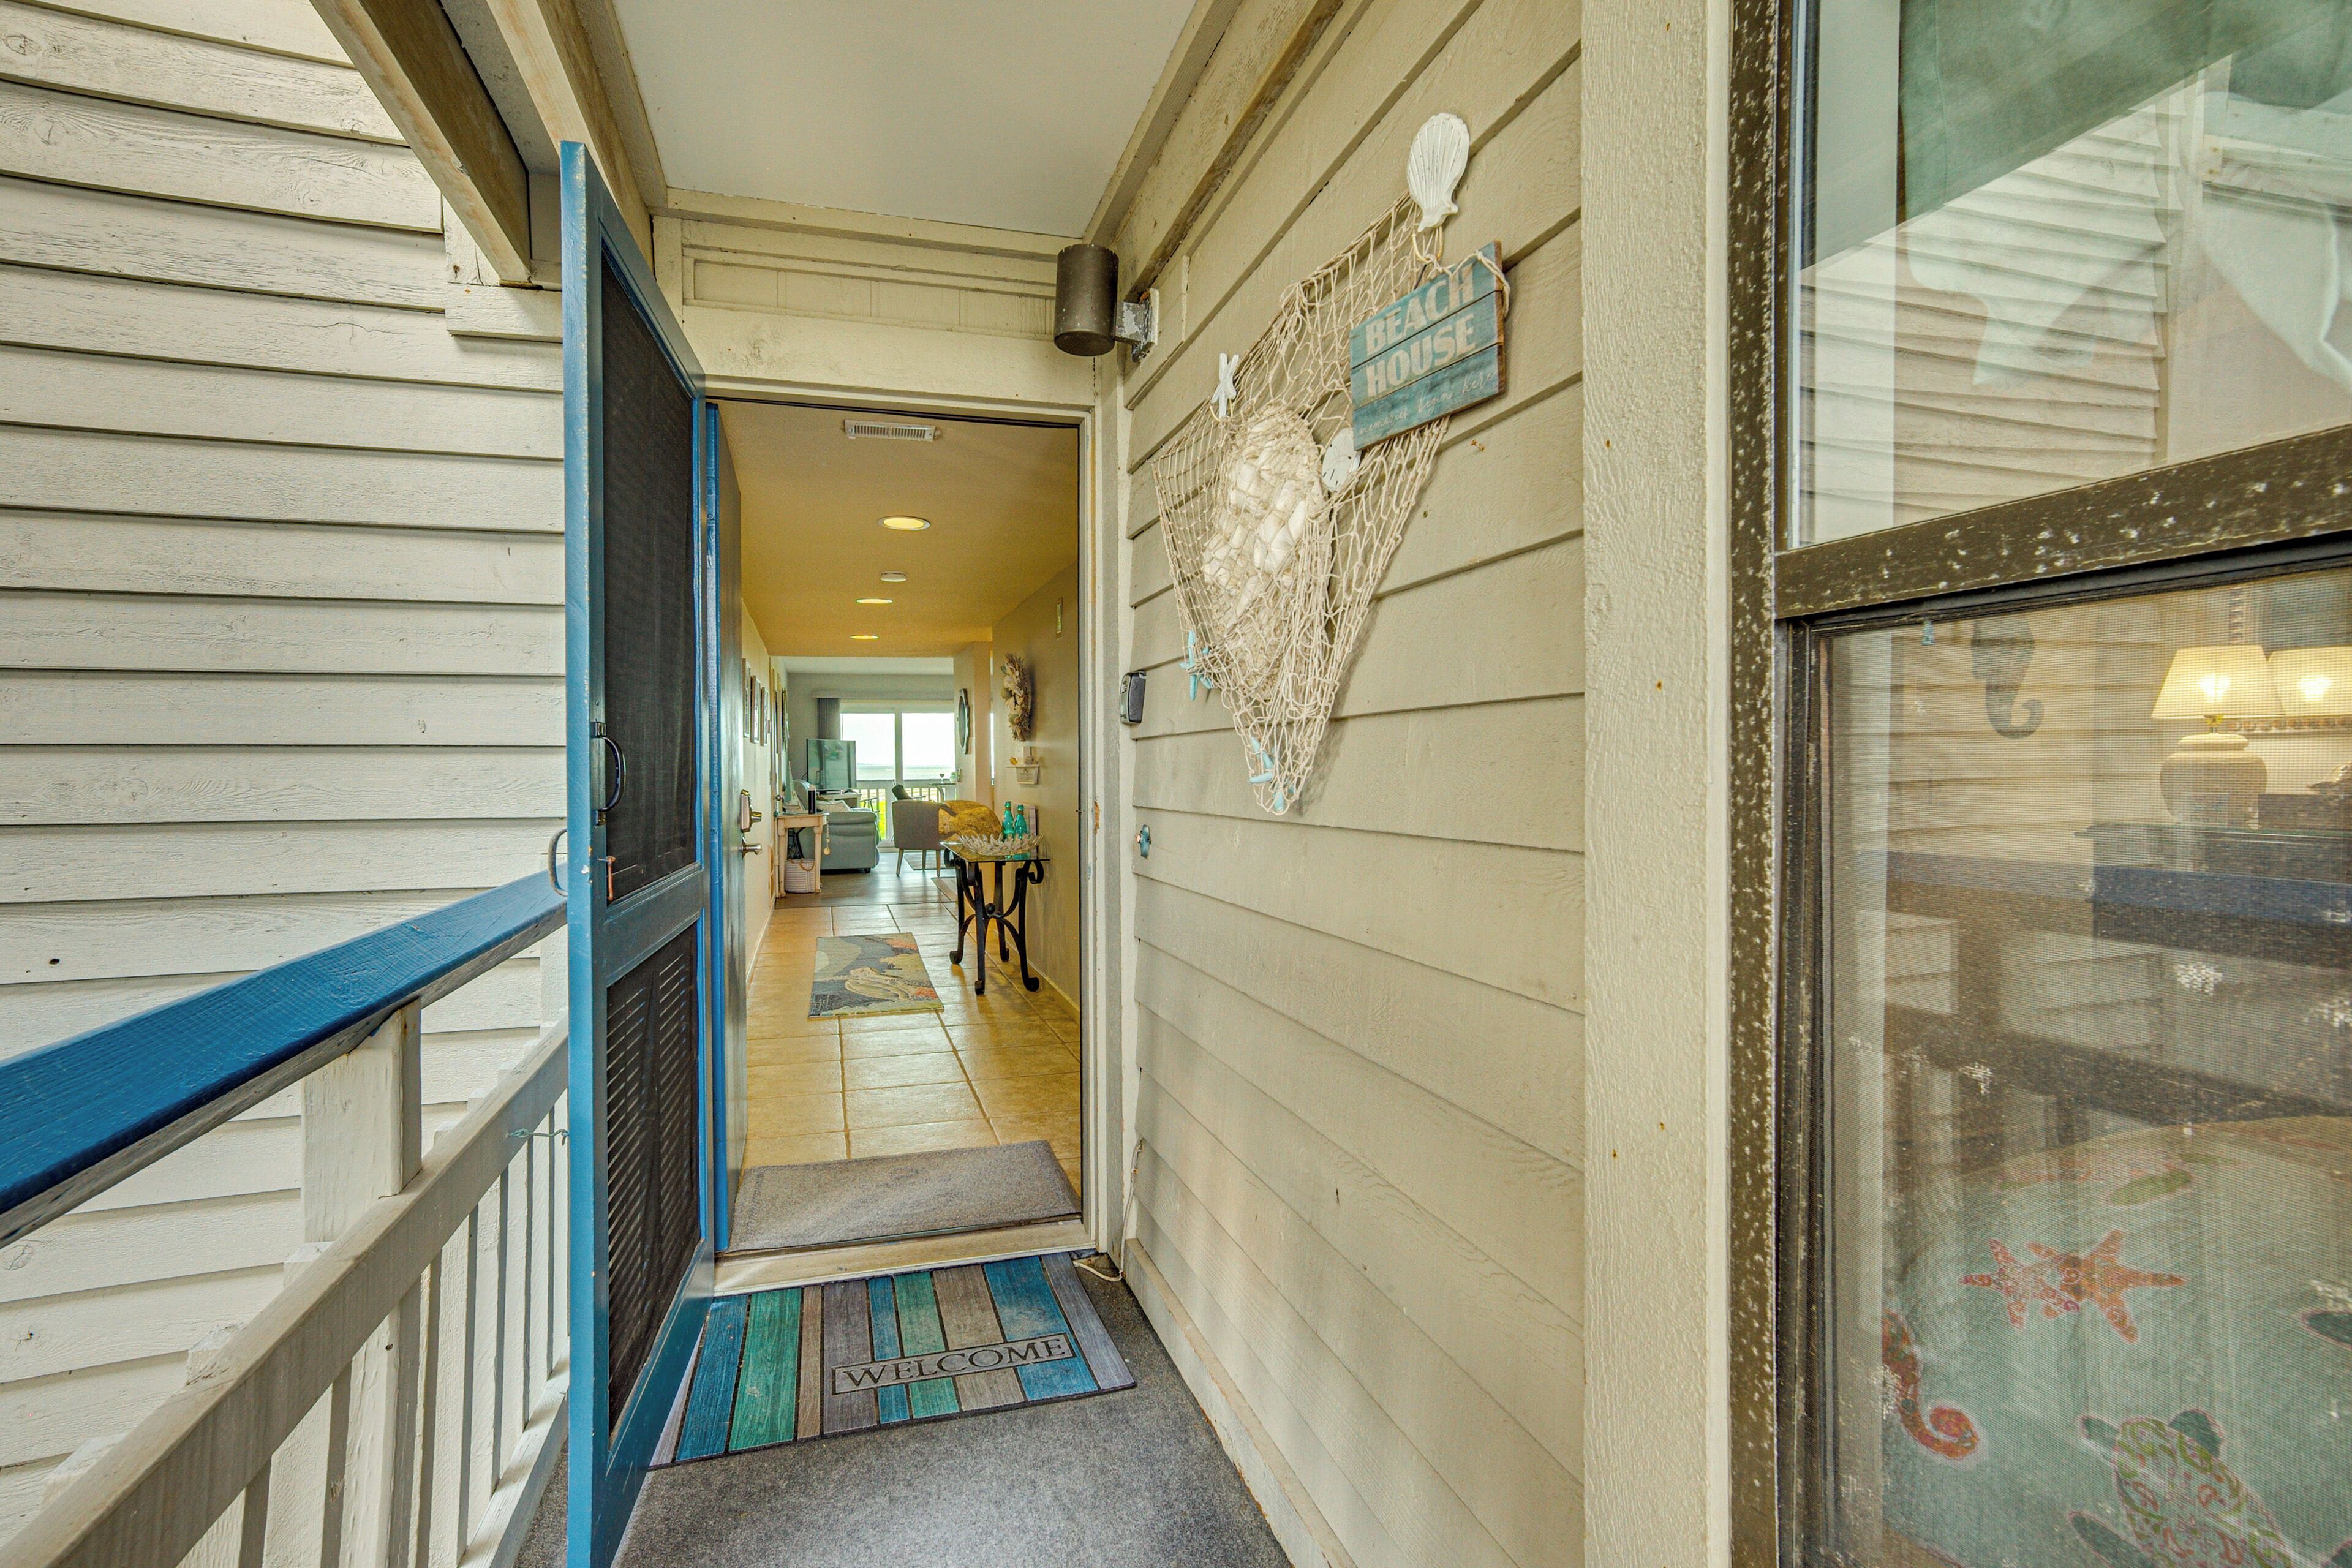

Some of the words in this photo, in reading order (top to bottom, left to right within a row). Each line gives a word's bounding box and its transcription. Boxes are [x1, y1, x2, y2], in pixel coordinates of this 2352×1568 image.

[1365, 263, 1474, 357] BEACH
[1365, 313, 1476, 397] HOUSE
[1461, 370, 1497, 395] here
[843, 1338, 1066, 1387] WELCOME
